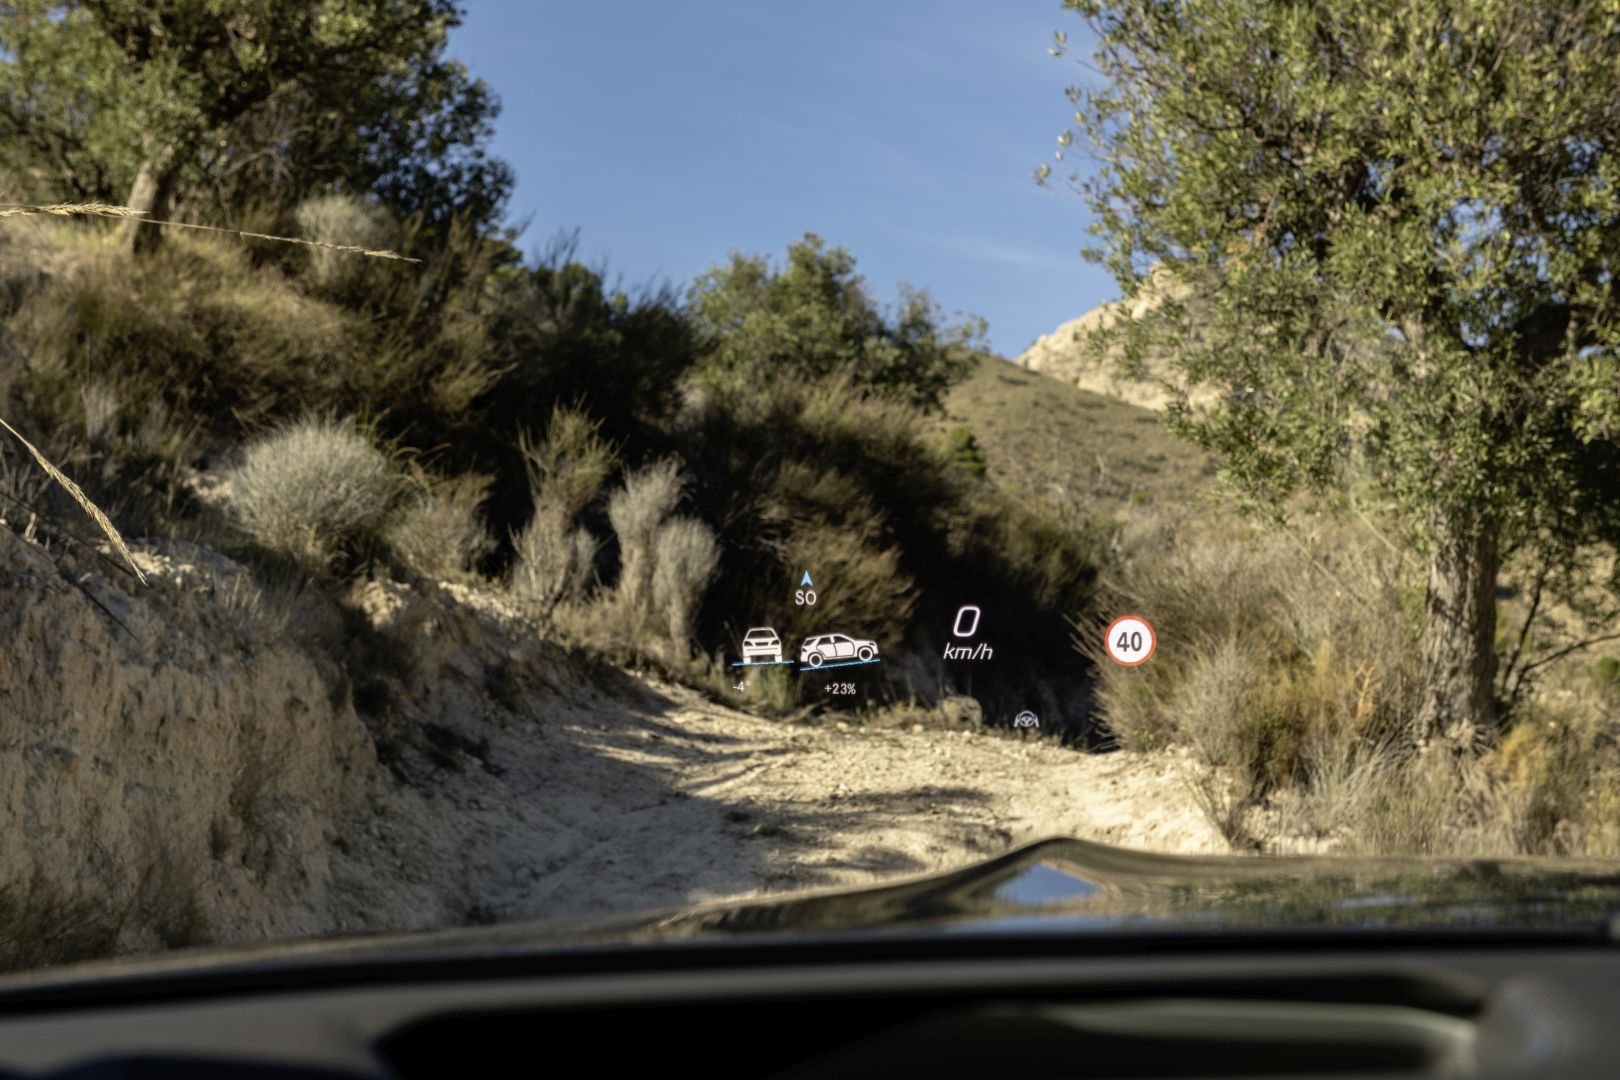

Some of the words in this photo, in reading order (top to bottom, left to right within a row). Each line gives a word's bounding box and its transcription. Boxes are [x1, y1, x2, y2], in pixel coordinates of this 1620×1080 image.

[794, 590, 817, 606] SO
[953, 605, 981, 638] 0
[1116, 631, 1143, 653] 40
[943, 643, 994, 661] km/h
[824, 683, 856, 695] +23%
